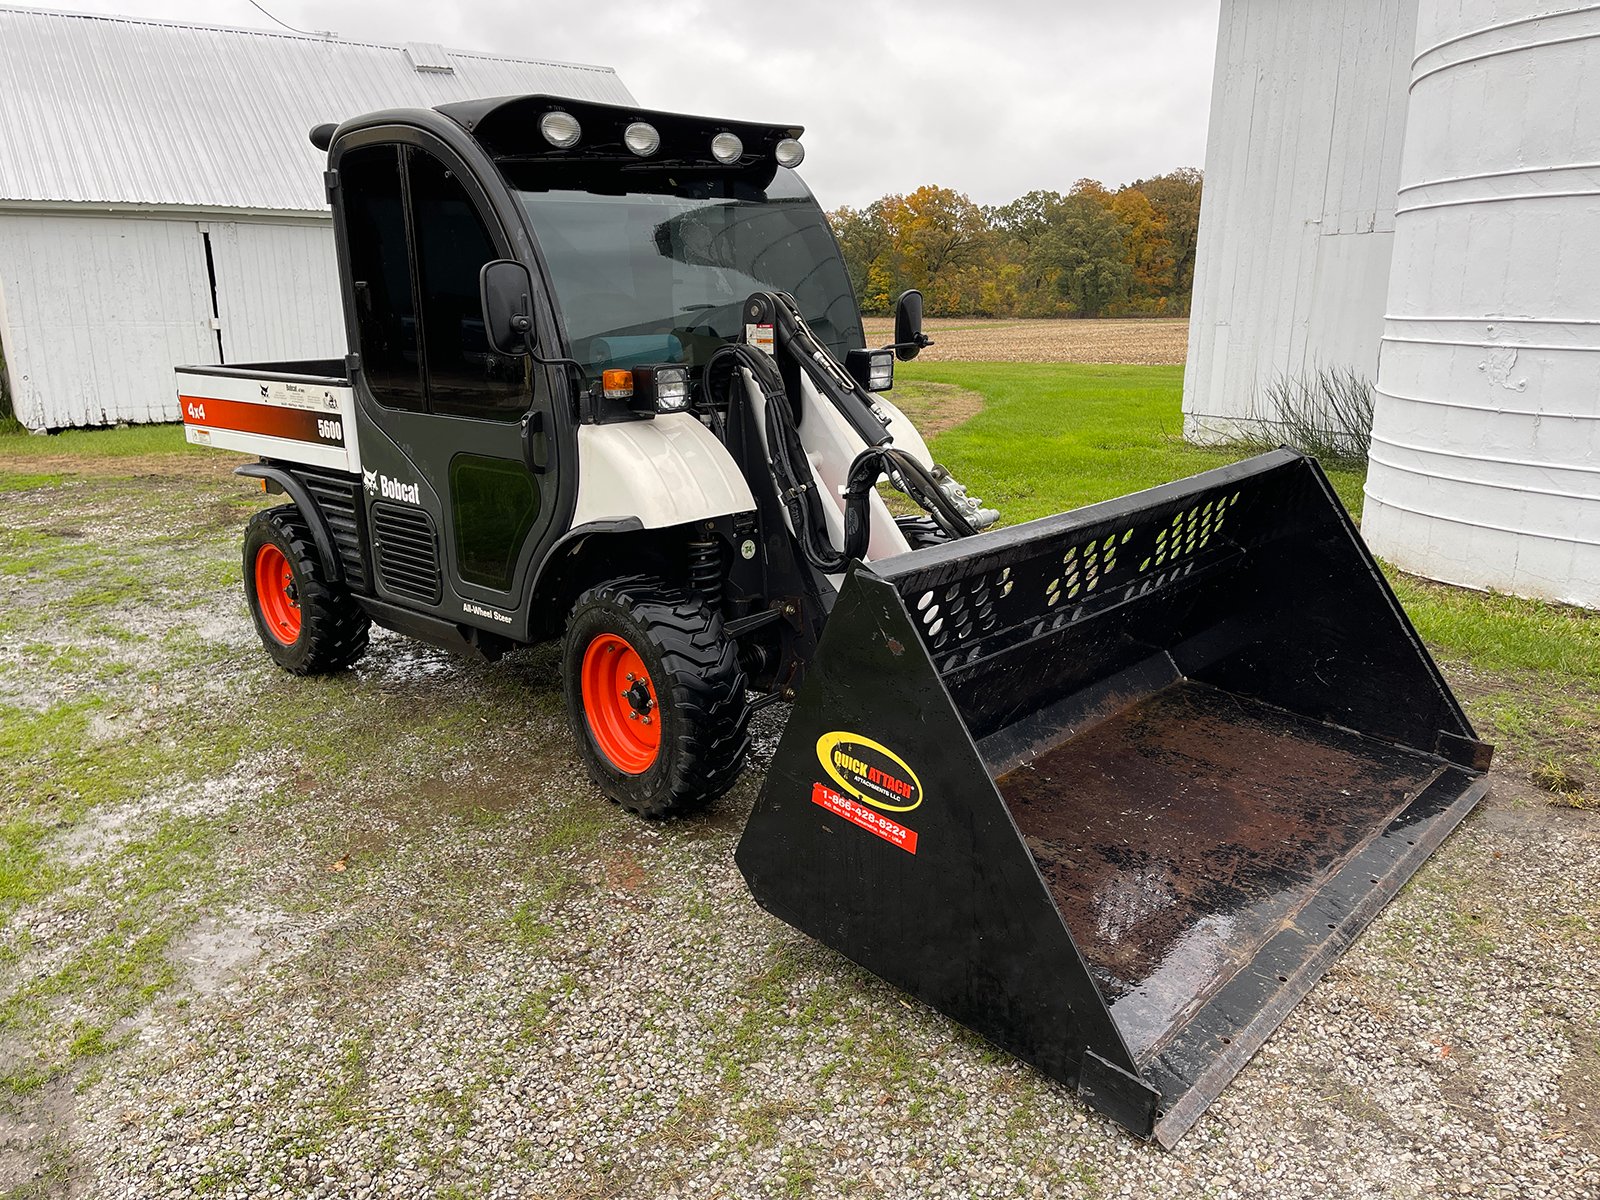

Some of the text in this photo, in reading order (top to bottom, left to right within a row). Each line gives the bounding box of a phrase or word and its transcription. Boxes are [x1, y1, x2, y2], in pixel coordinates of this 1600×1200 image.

[187, 402, 206, 420] 4x4
[317, 419, 342, 441] 5600
[380, 474, 421, 505] Bobcat
[463, 603, 513, 624] All-Wheel Steer
[834, 750, 869, 778] QUICK
[854, 775, 901, 802] ATTACHMENTS LLC
[822, 790, 907, 839] 1-866-428-8224
